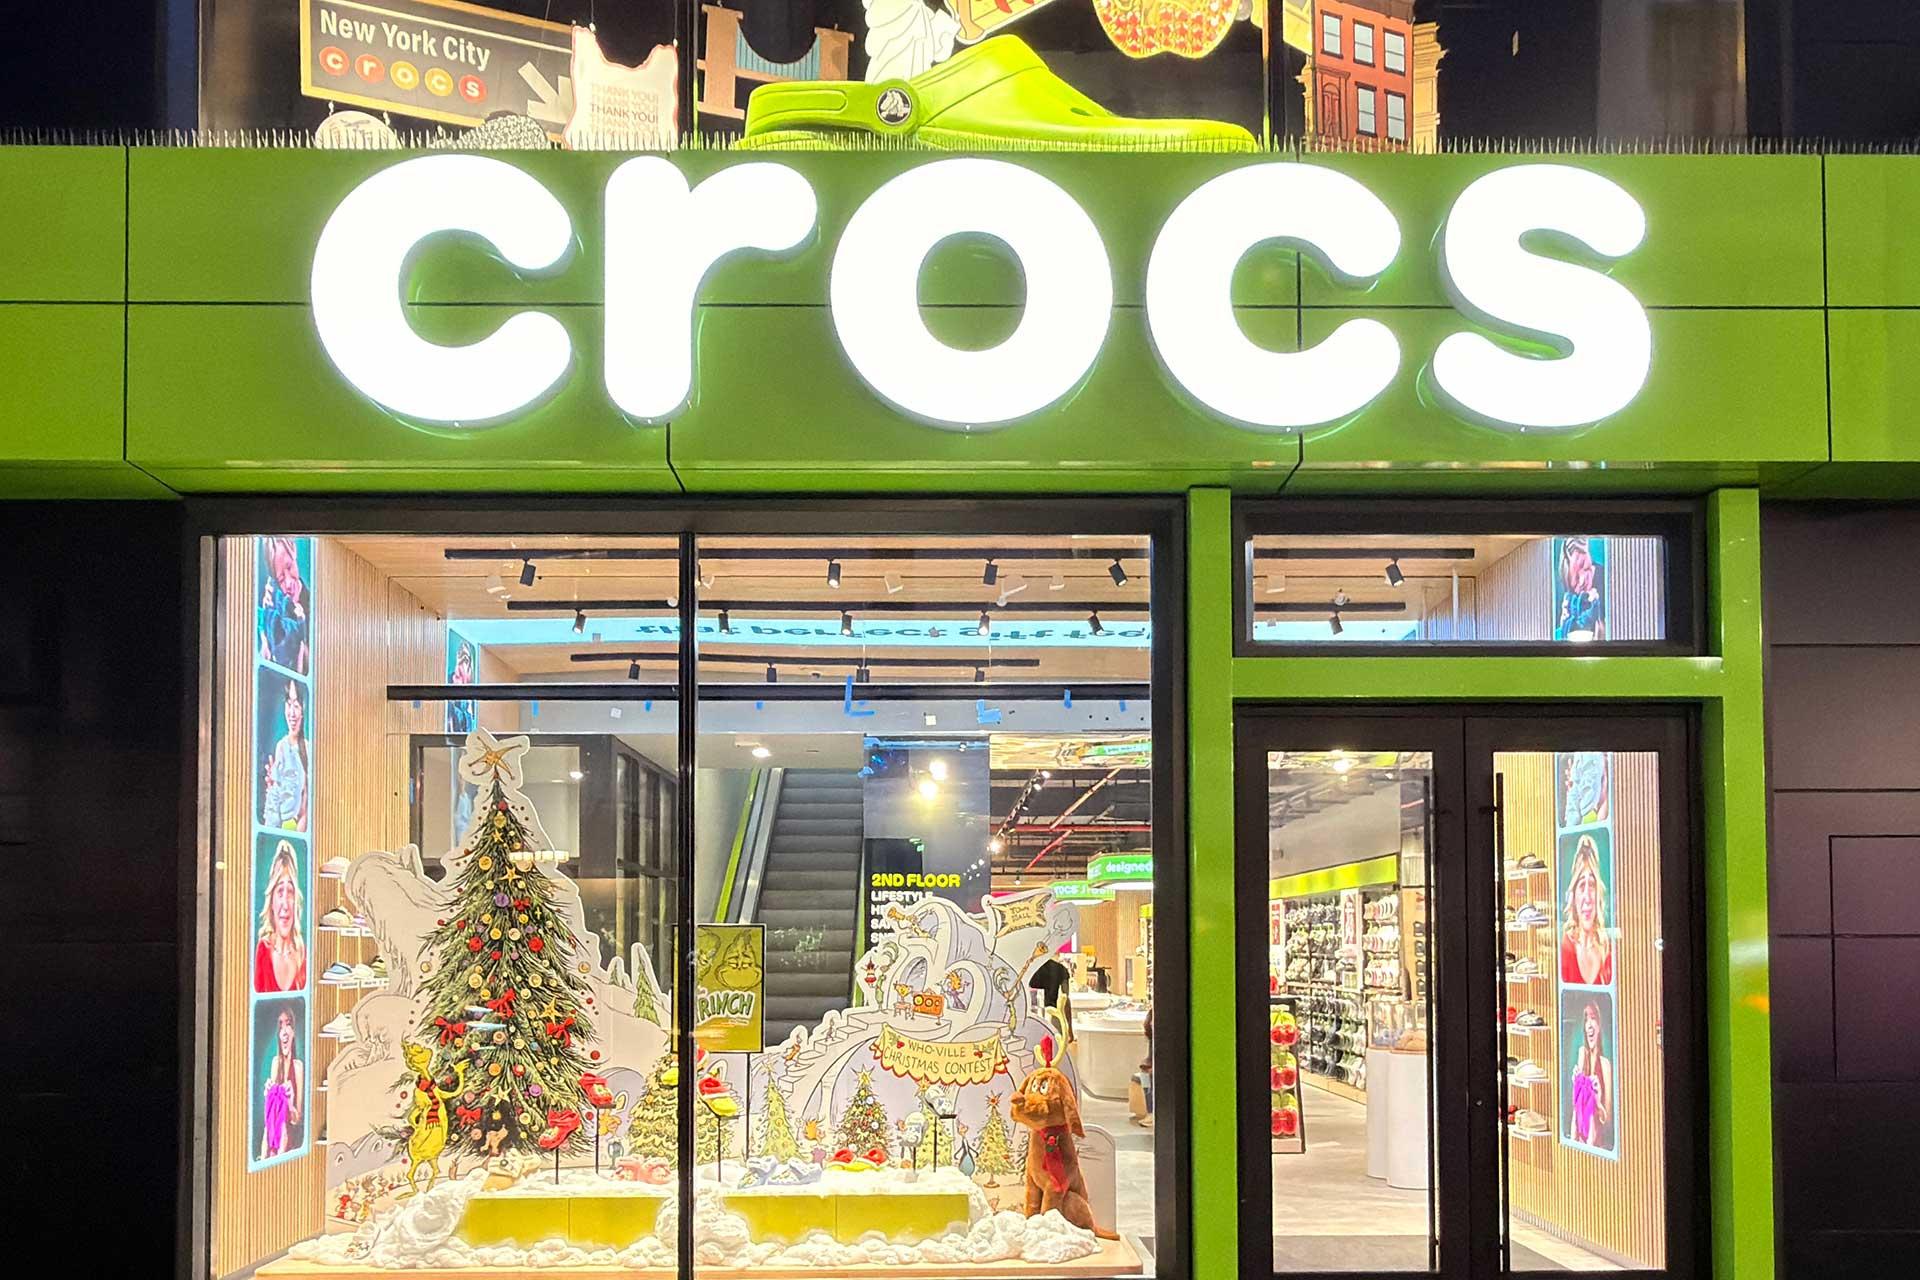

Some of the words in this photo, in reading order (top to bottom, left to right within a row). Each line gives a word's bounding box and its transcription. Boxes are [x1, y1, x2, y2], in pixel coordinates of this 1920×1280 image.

[320, 9, 376, 44] New
[381, 22, 438, 57] York
[443, 36, 490, 72] City
[591, 103, 630, 120] THANK
[311, 154, 1652, 427] crocs
[871, 873, 904, 887] 2ND
[906, 873, 961, 888] FLOOR
[698, 993, 755, 1021] RINCH
[883, 1046, 940, 1074] CHRISTMAS
[944, 1058, 992, 1075] CONTEST
[908, 1040, 966, 1058] WHO-VILLE
